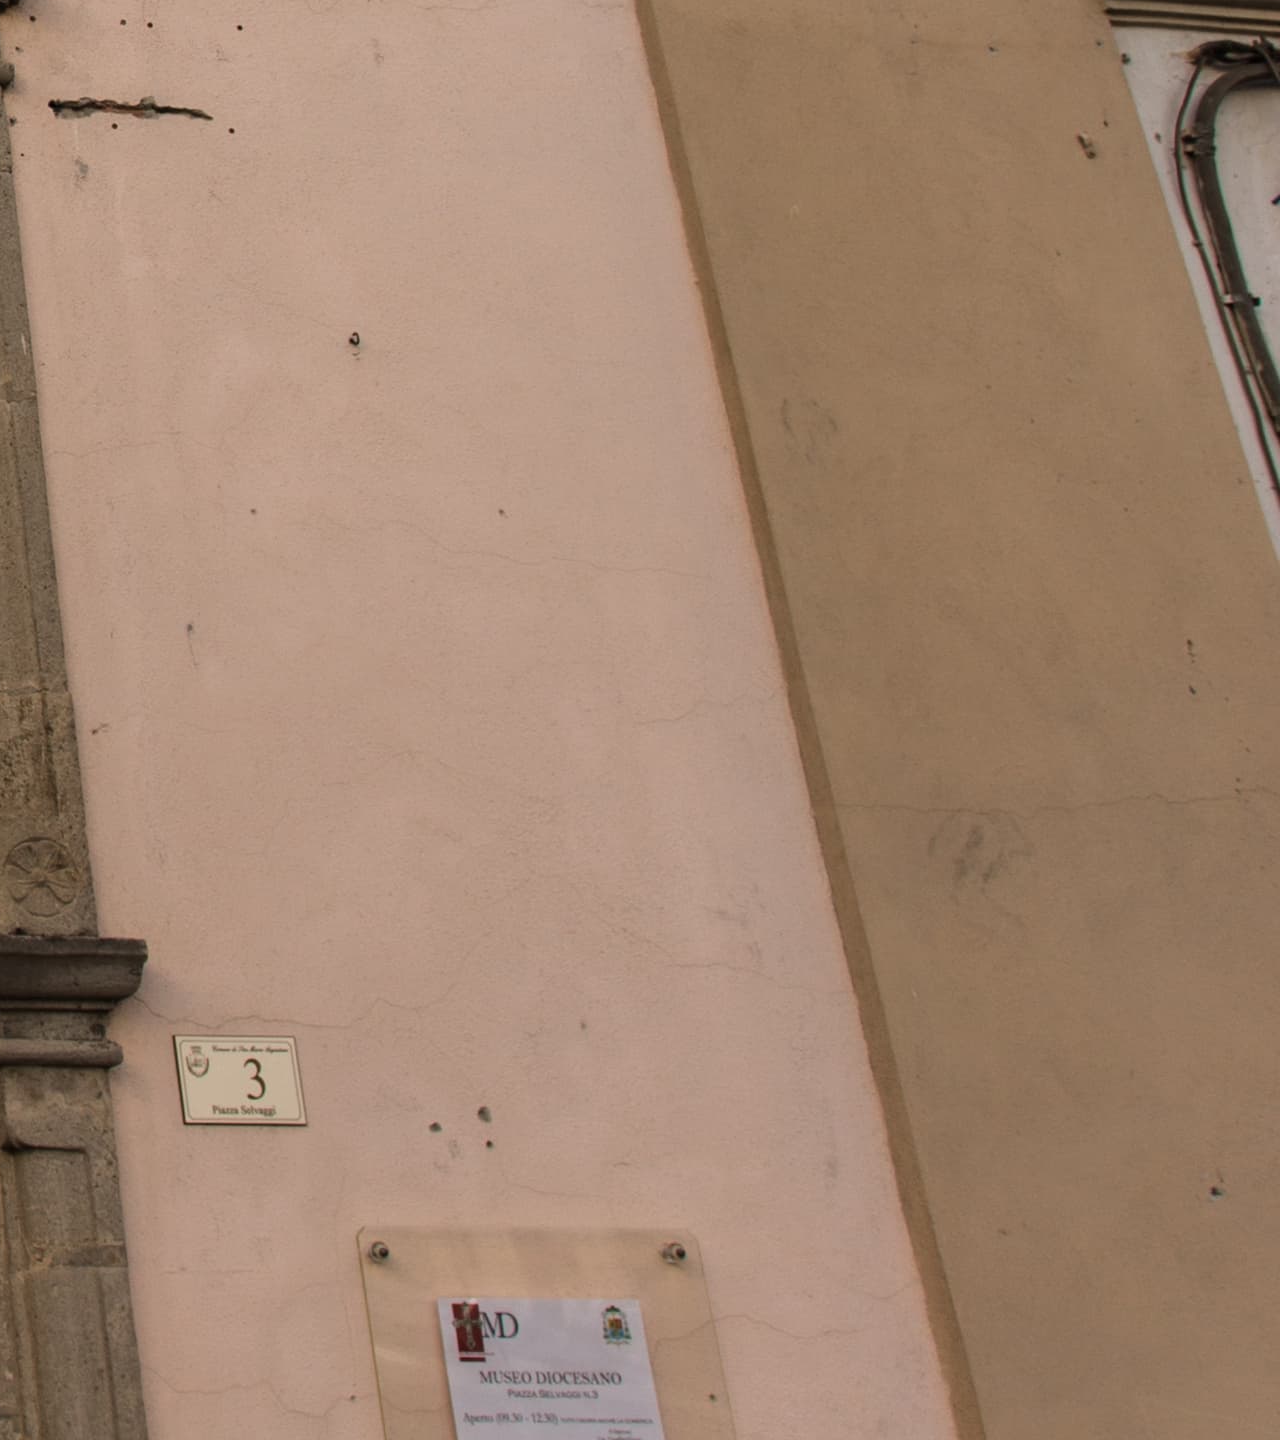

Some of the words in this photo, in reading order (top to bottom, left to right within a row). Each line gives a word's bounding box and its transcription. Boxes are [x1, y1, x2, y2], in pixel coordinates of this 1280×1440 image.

[243, 1058, 266, 1100] 3
[212, 1105, 239, 1115] Piazza
[479, 1370, 532, 1385] MUSEO
[535, 1370, 623, 1386] DIOCESANO
